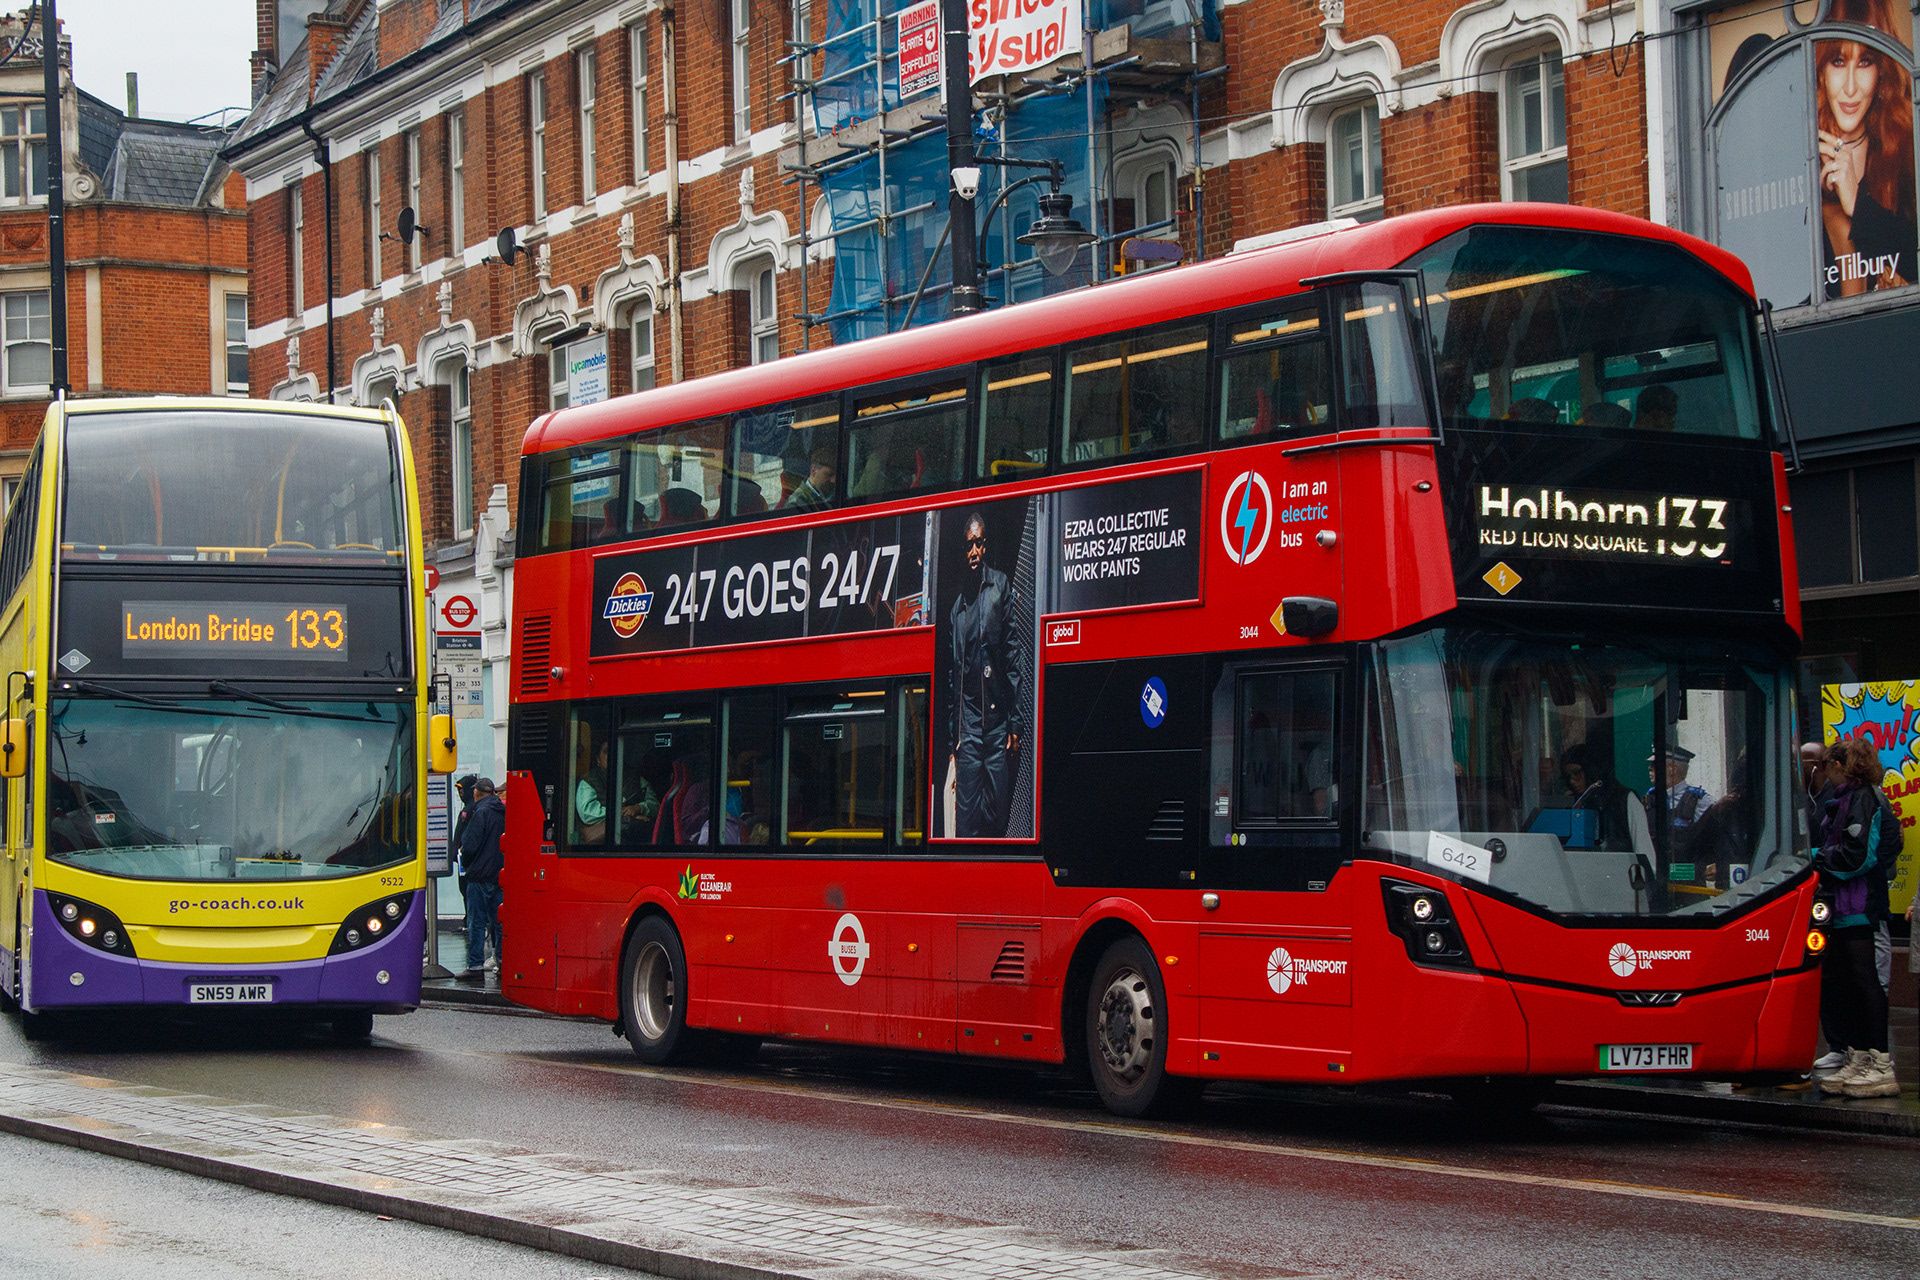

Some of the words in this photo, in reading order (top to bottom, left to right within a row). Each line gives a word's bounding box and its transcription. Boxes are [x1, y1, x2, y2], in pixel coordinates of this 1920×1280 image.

[901, 3, 937, 30] WARNING
[900, 34, 924, 54] ALARMS
[927, 31, 934, 43] 4
[901, 51, 939, 76] SCAFFOLDING
[571, 351, 607, 375] Lycamobile
[1282, 481, 1287, 499] I
[1290, 482, 1308, 498] am
[1312, 480, 1327, 496] an
[1281, 502, 1328, 523] electric
[1481, 486, 1649, 526] Holborn
[1065, 520, 1095, 539] EZRA
[1096, 508, 1169, 535] COLLECTIVE
[1063, 540, 1105, 561] WEARS
[1107, 536, 1128, 556] 247
[1130, 529, 1186, 553] REGULAR
[1280, 530, 1303, 548] bus
[1479, 528, 1517, 546] RED
[1522, 531, 1568, 549] LION
[1573, 533, 1649, 554] SQUARE
[424, 570, 434, 589] T
[1063, 562, 1099, 583] WORK
[1101, 557, 1140, 579] PANTS
[664, 569, 717, 626] 247
[723, 556, 811, 619] GOES
[819, 544, 901, 609] 24/7
[609, 597, 647, 614] Dickies
[126, 613, 201, 641] London
[208, 614, 275, 641] Bridge
[285, 609, 344, 649] 133
[1053, 623, 1074, 642] global
[1239, 625, 1259, 639] 3044
[1442, 847, 1477, 871] 642
[380, 877, 404, 886] 9522
[169, 897, 304, 913] go-coach.co.uk
[1745, 929, 1770, 942] 3044
[841, 945, 857, 954] BUSES
[1636, 950, 1691, 961] TRANSPORT
[1294, 958, 1347, 975] TRANSPORT
[1638, 960, 1653, 970] UK
[1295, 972, 1308, 986] UK
[196, 987, 234, 1000] SN59
[239, 986, 266, 999] AWR
[1610, 1047, 1654, 1066] LV73
[1657, 1047, 1689, 1066] FHR
